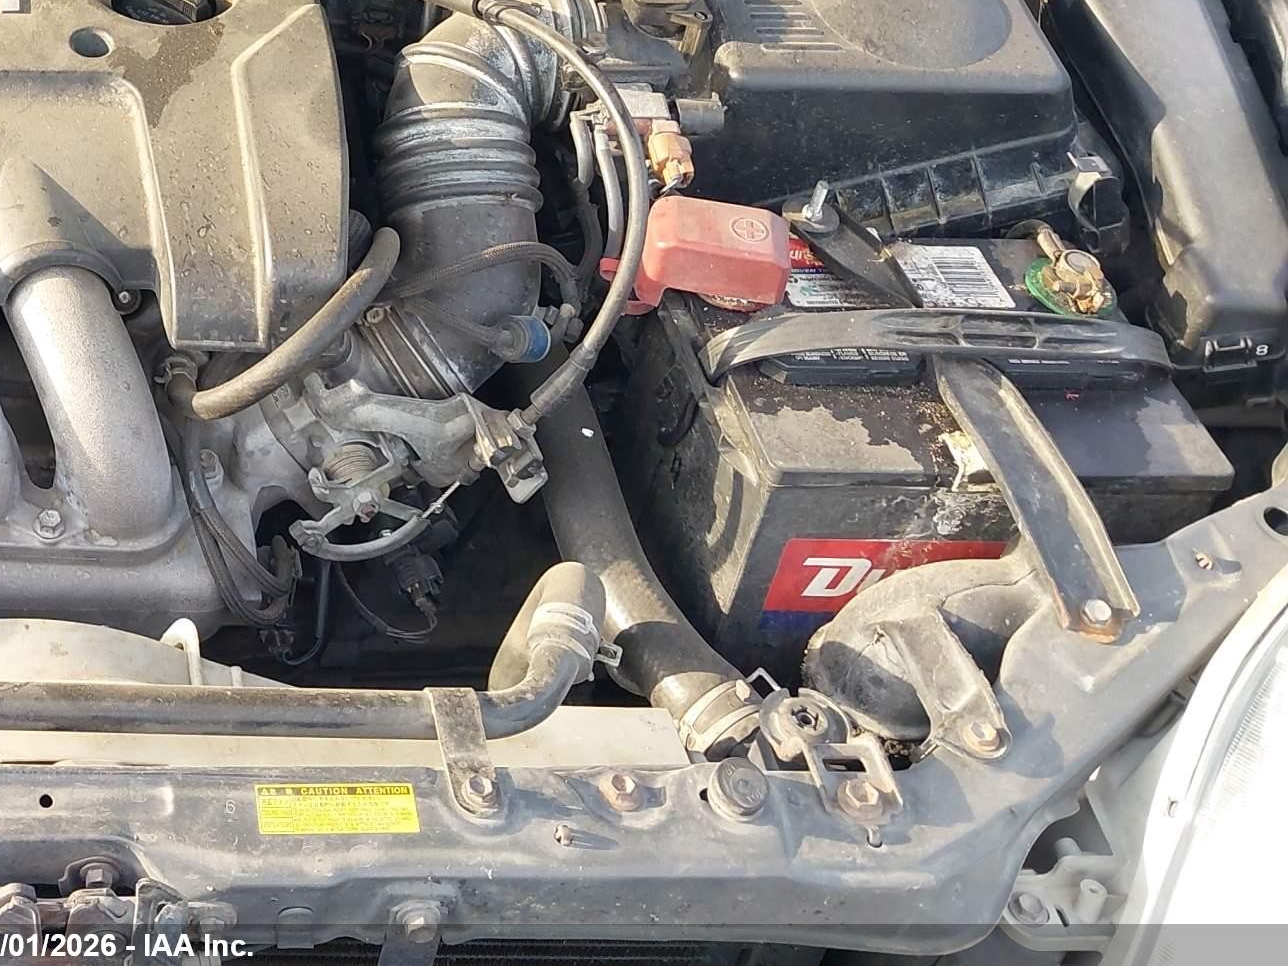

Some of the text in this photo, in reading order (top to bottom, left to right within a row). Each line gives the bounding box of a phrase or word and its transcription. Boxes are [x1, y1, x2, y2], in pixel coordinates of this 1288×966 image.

[1255, 344, 1269, 356] 8
[300, 786, 348, 795] CAUTION
[355, 786, 408, 795] ATTENTION
